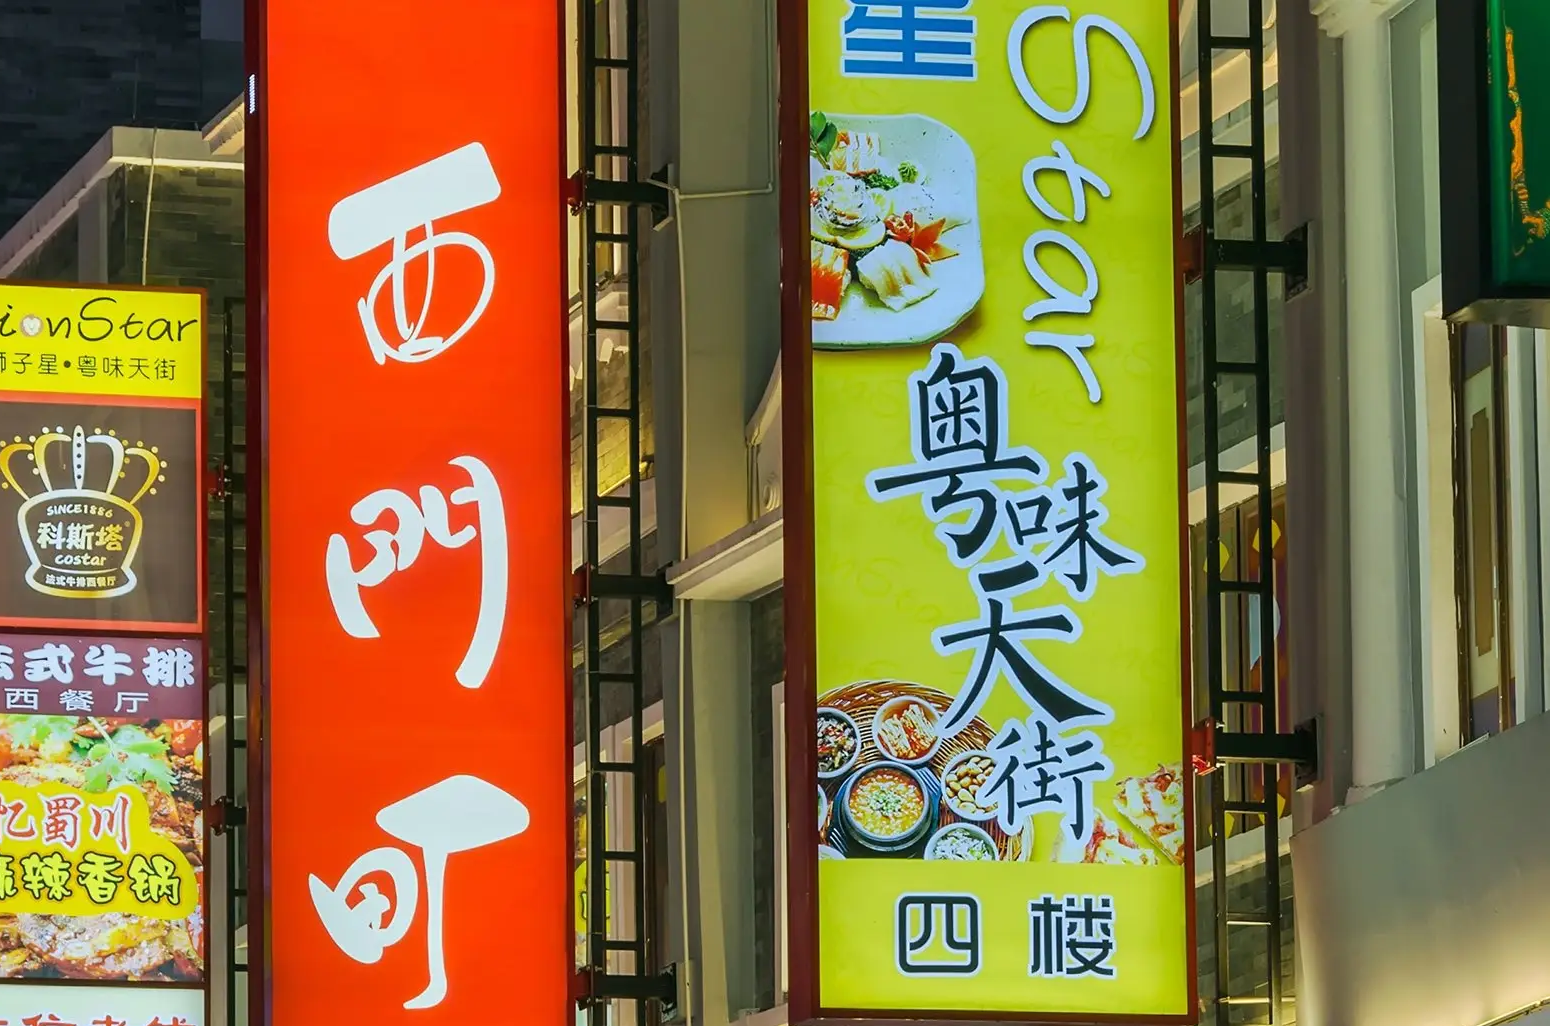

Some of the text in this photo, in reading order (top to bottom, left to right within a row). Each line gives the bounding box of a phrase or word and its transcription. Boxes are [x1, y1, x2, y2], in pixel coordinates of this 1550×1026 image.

[1007, 5, 1155, 403] Star
[36, 521, 124, 551] 科斯塔
[54, 553, 107, 566] costar
[874, 352, 1138, 842] 粤味天街
[4, 687, 150, 715] 西餐厅
[896, 894, 1116, 977] 四楼
